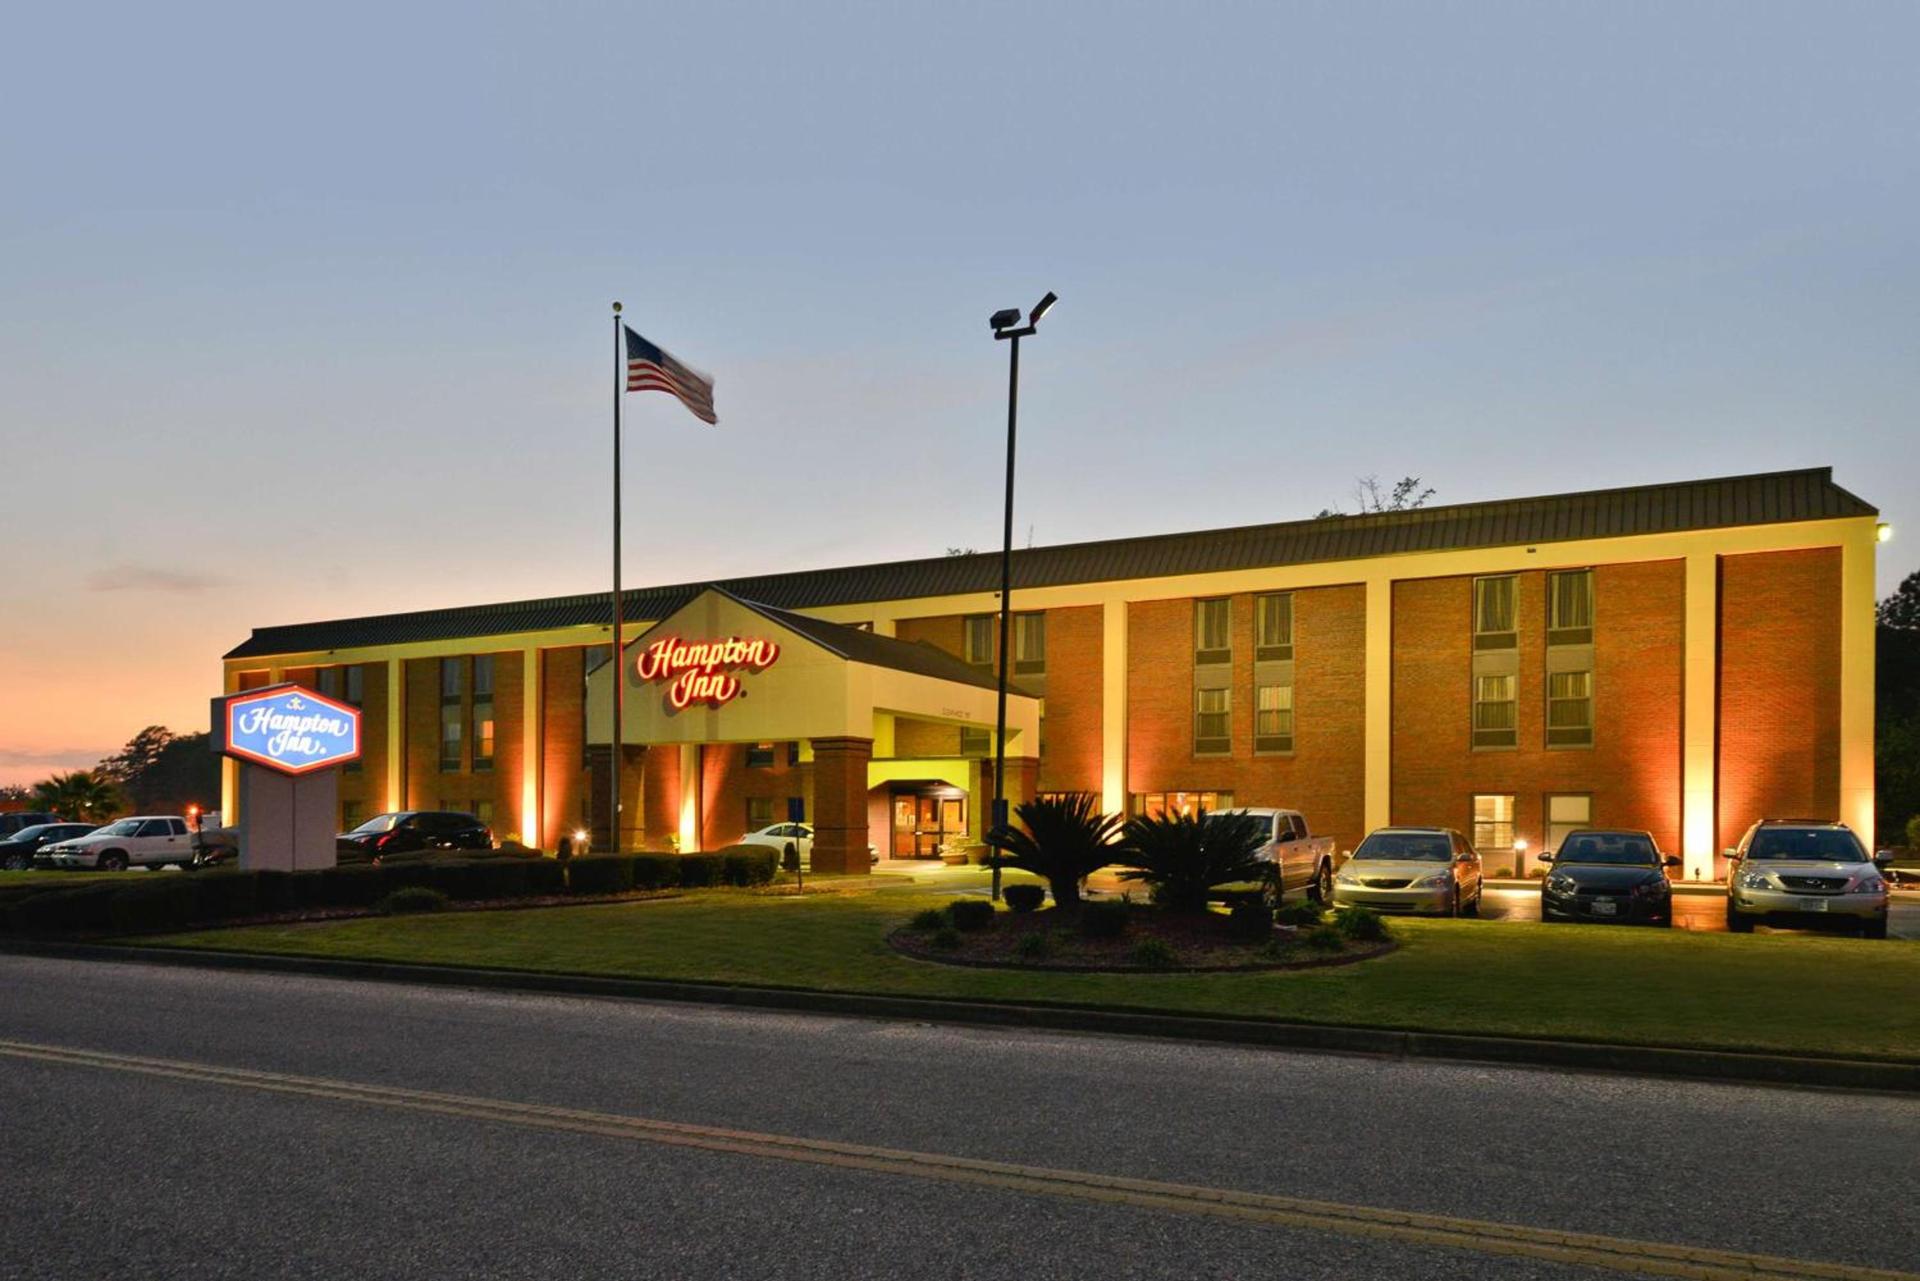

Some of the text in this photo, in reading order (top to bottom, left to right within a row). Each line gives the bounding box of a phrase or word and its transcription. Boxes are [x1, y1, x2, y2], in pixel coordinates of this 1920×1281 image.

[636, 636, 778, 680] Hampton
[670, 668, 738, 708] Inn
[239, 707, 349, 737] Hampton
[267, 730, 320, 757] Inn
